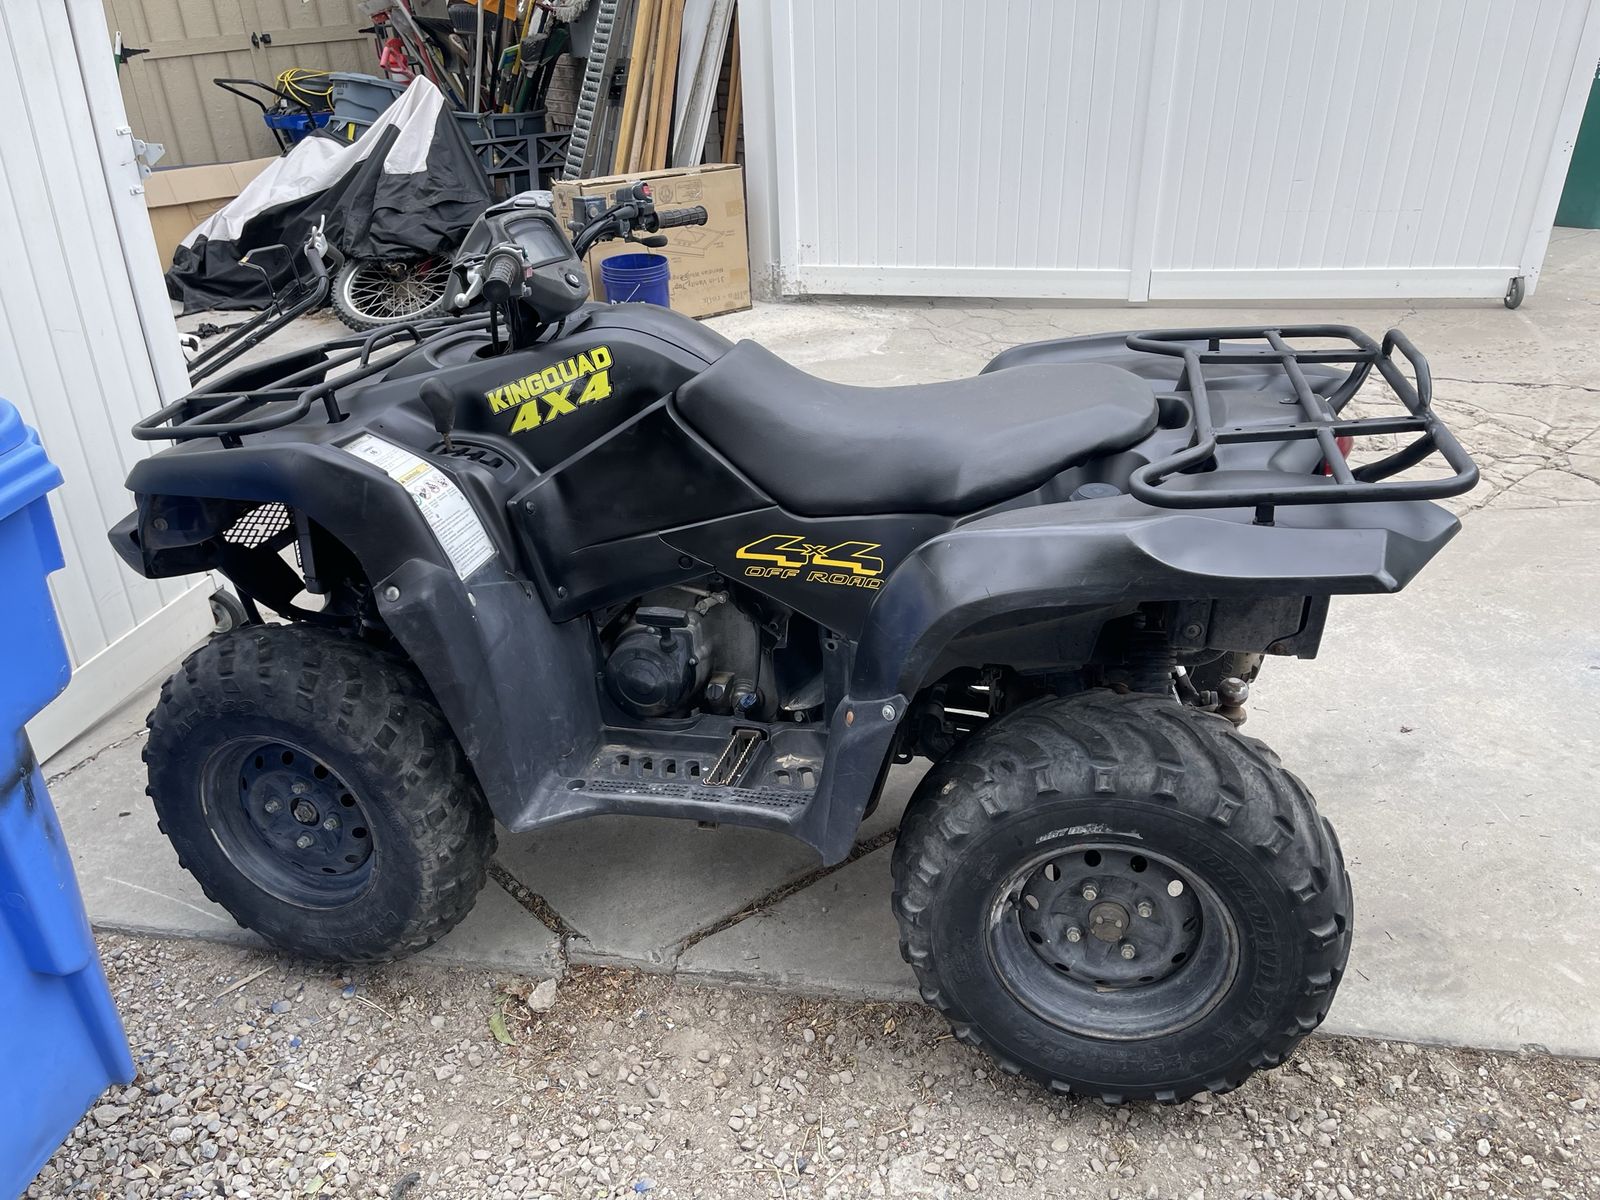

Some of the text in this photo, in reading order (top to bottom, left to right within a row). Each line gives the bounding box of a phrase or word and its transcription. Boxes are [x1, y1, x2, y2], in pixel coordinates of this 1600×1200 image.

[486, 345, 613, 414] KINGQUAD
[744, 565, 885, 590] OFF ROAD
